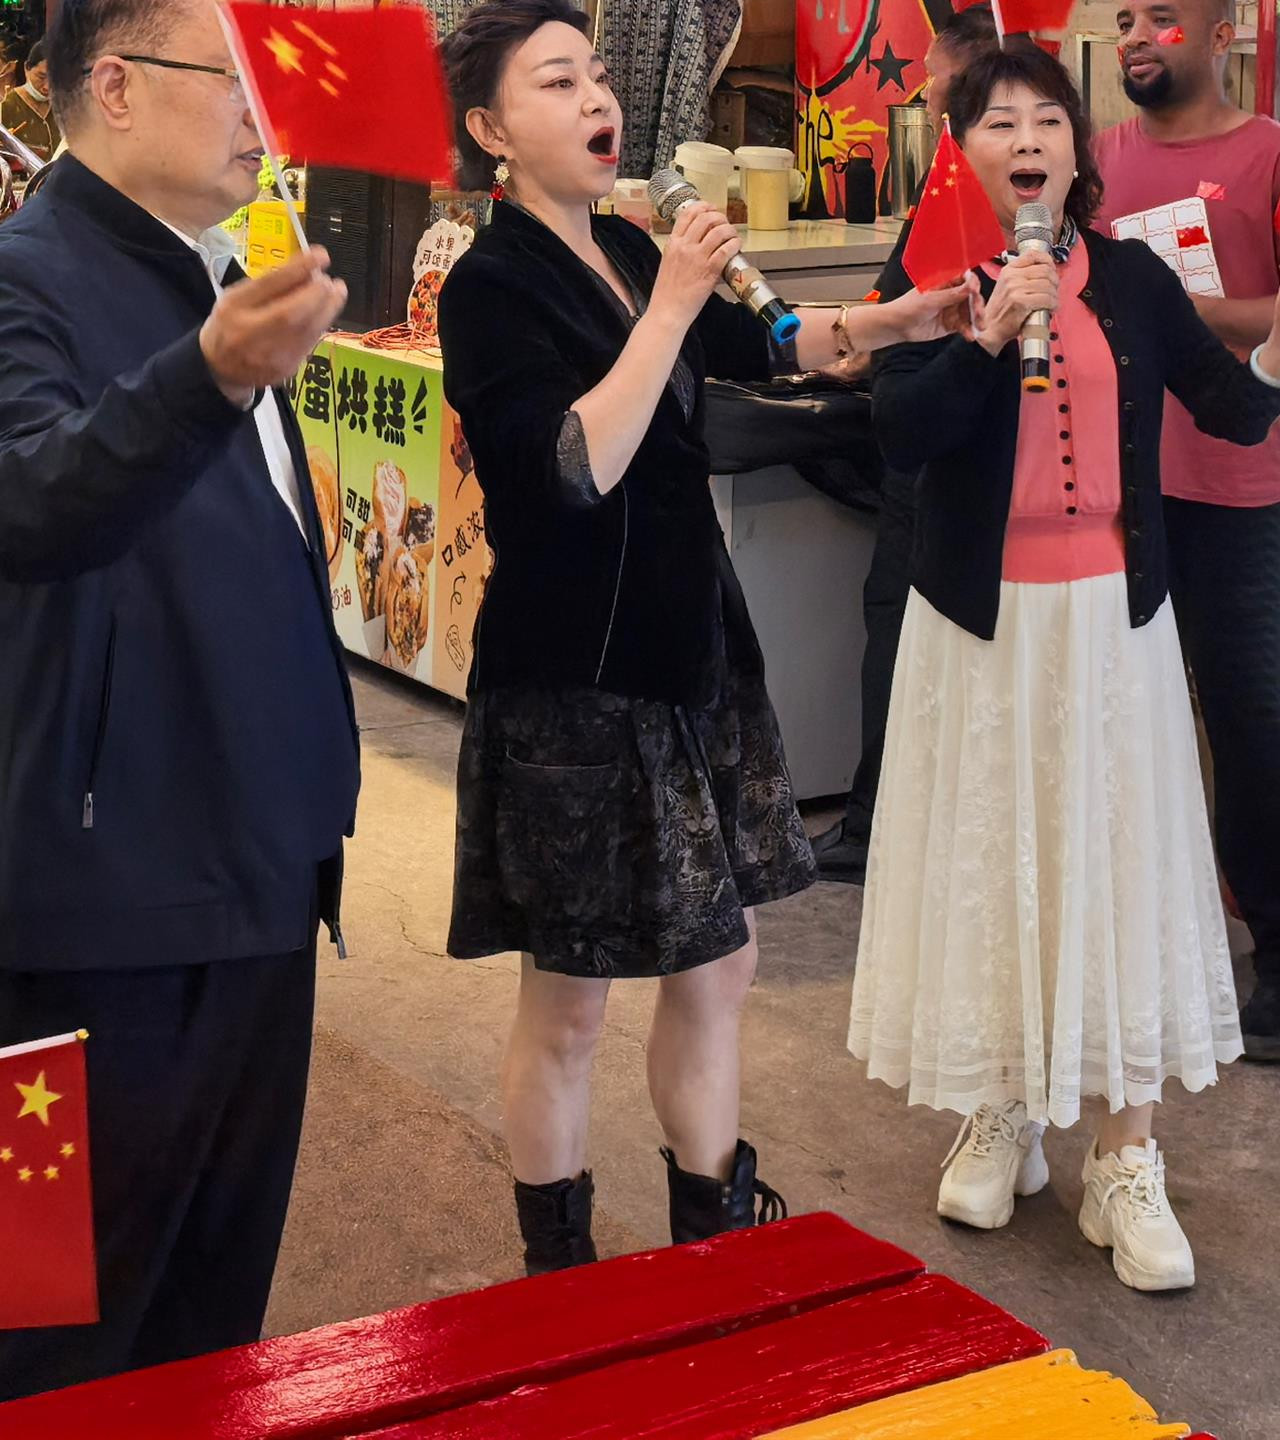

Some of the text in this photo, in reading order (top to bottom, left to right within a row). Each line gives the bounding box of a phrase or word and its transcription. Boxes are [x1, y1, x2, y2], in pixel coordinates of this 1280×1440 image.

[422, 249, 457, 270] 可颂蛋
[290, 355, 407, 448] 蛋烘糕
